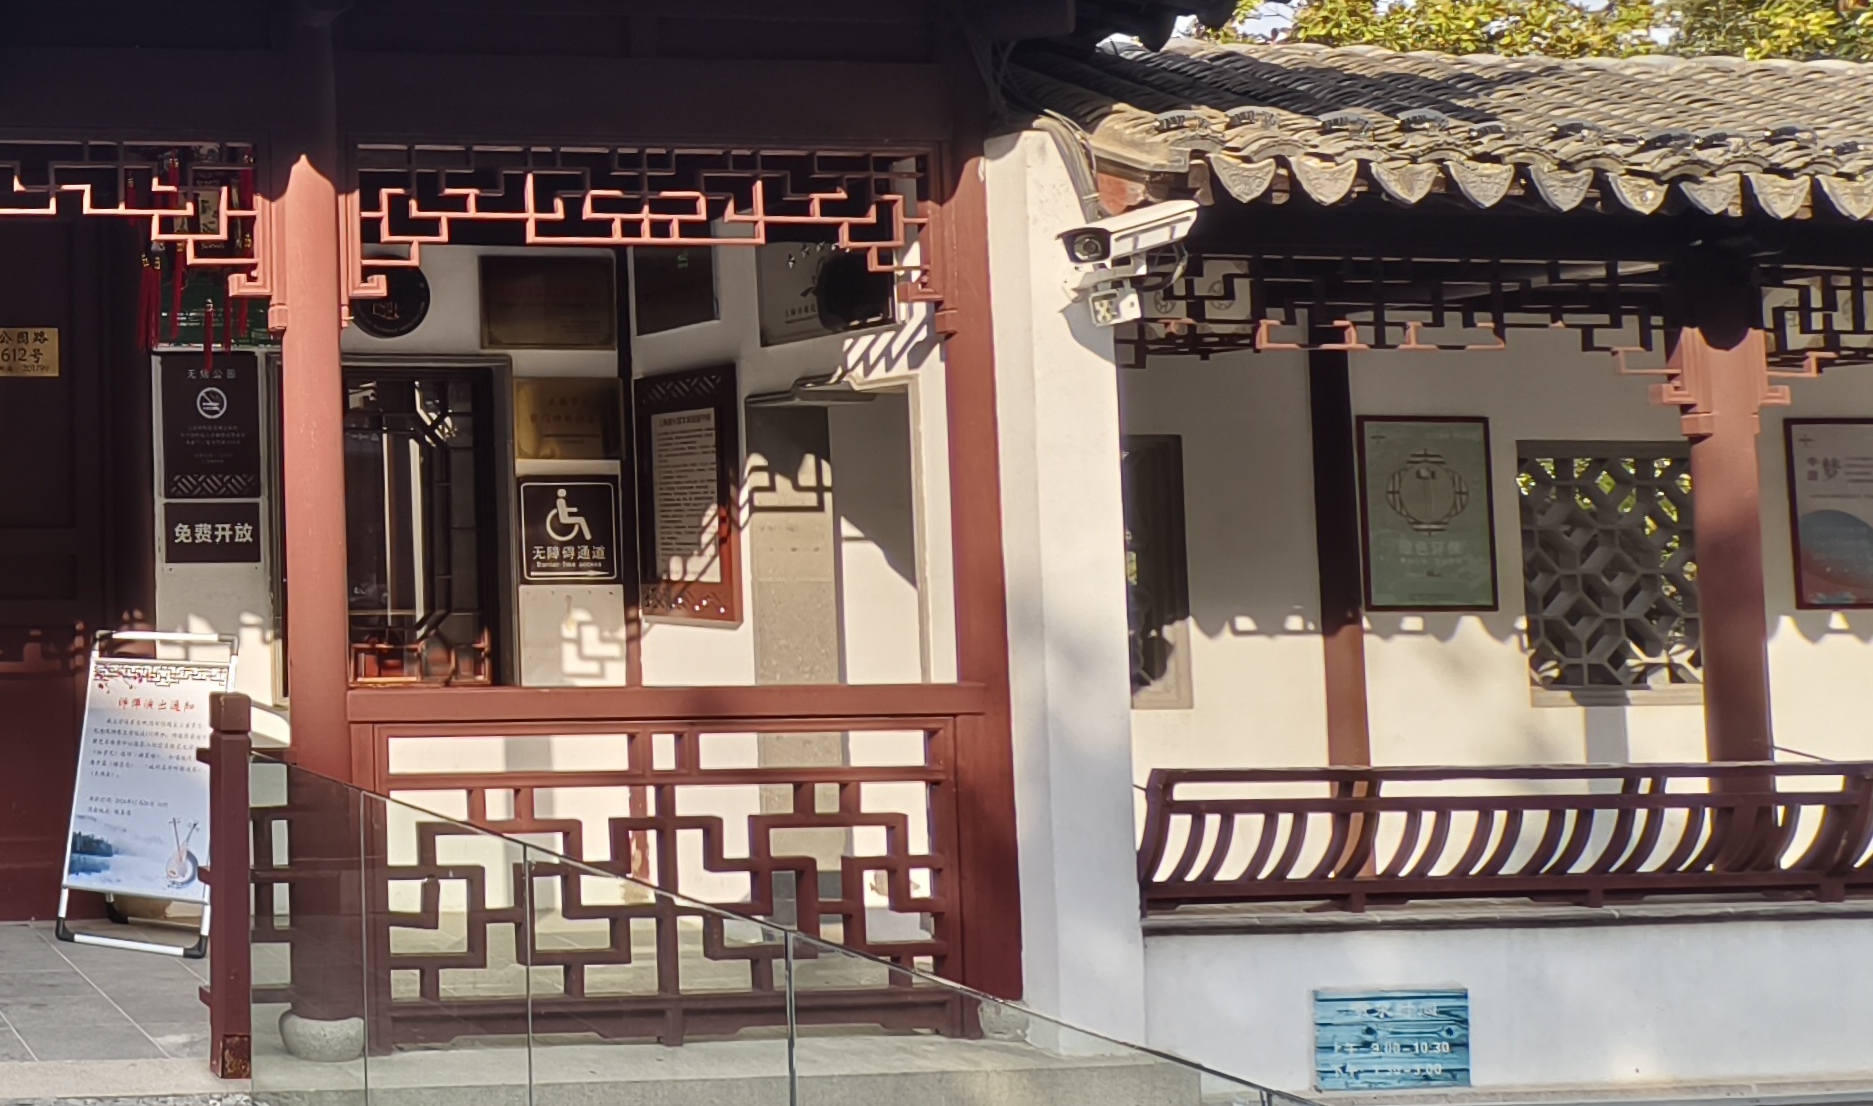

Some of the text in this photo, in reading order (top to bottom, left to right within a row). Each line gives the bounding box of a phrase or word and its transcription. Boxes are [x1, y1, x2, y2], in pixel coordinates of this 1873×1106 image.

[1, 348, 44, 364] 612号
[187, 368, 236, 379] 无烟公园
[174, 523, 253, 543] 免费开放
[532, 545, 606, 560] 无障碍通道
